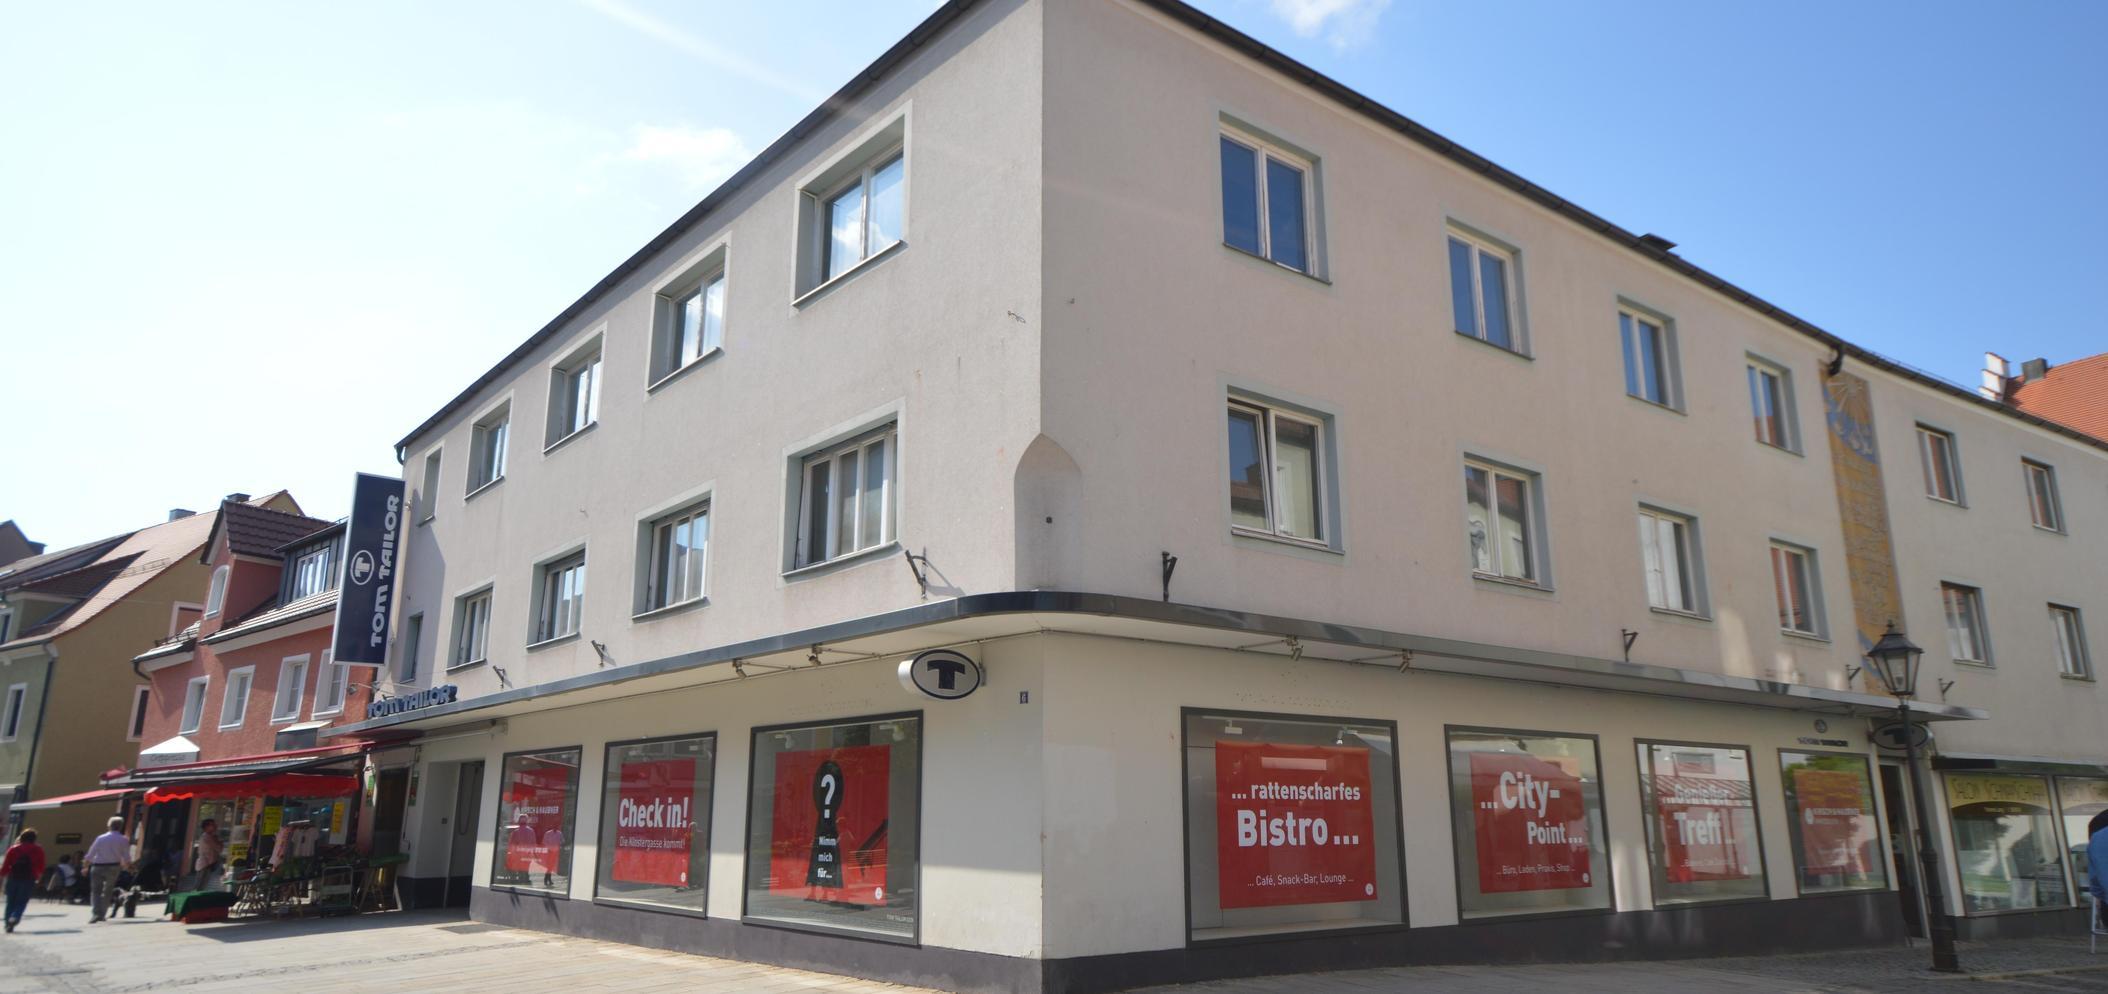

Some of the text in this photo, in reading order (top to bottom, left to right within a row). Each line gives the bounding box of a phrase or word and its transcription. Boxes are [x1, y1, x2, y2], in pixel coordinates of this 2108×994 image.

[370, 494, 400, 648] TOM TAILOR
[927, 659, 966, 690] T
[367, 684, 458, 719] TOM TAILOR
[1251, 782, 1361, 801] rattenscharfes
[619, 796, 689, 829] Check in!
[1237, 809, 1329, 847] Bistro
[619, 836, 629, 847] Die
[818, 836, 837, 846] Nimm
[1673, 811, 1721, 846] Treff
[818, 852, 833, 862] mich
[1255, 874, 1276, 888] Café,
[1277, 873, 1319, 885] Snack-Bar,
[1320, 873, 1347, 886] Lounge
